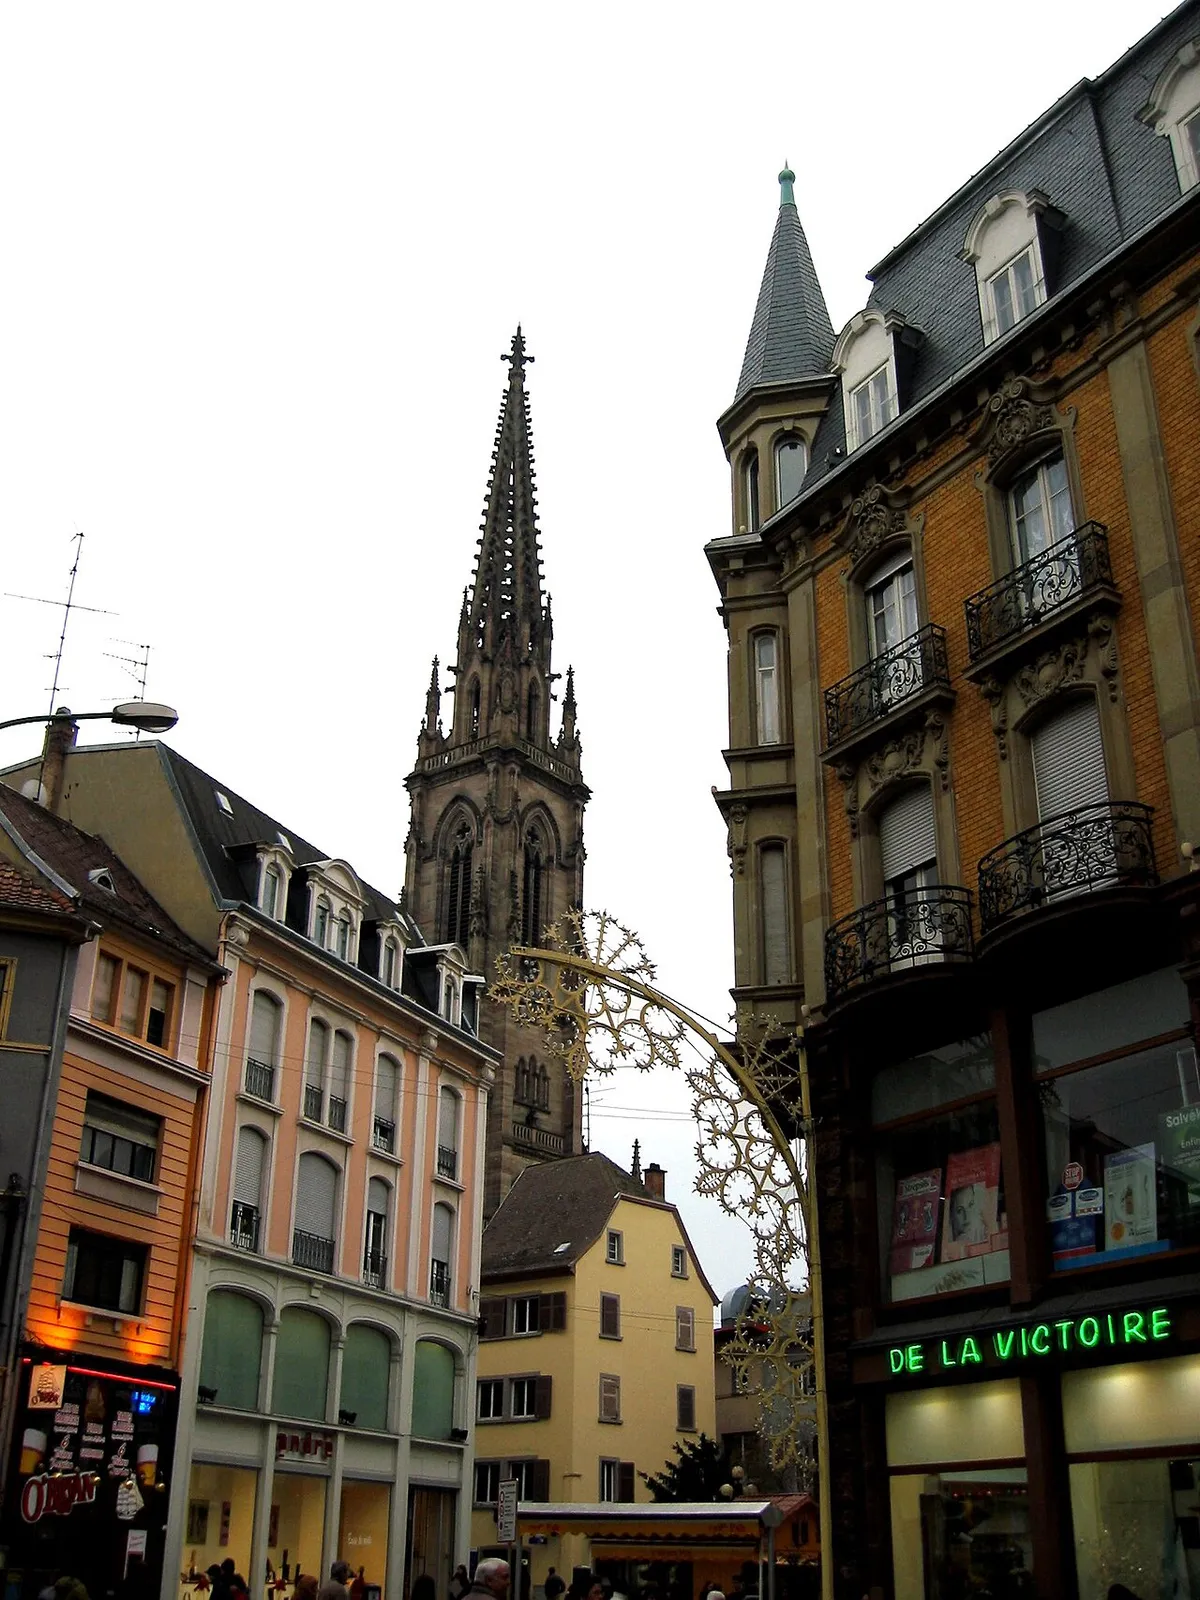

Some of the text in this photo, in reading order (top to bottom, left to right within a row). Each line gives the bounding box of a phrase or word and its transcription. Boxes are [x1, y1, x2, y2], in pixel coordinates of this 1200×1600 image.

[889, 1309, 1170, 1372] DE LA VICTOIRE
